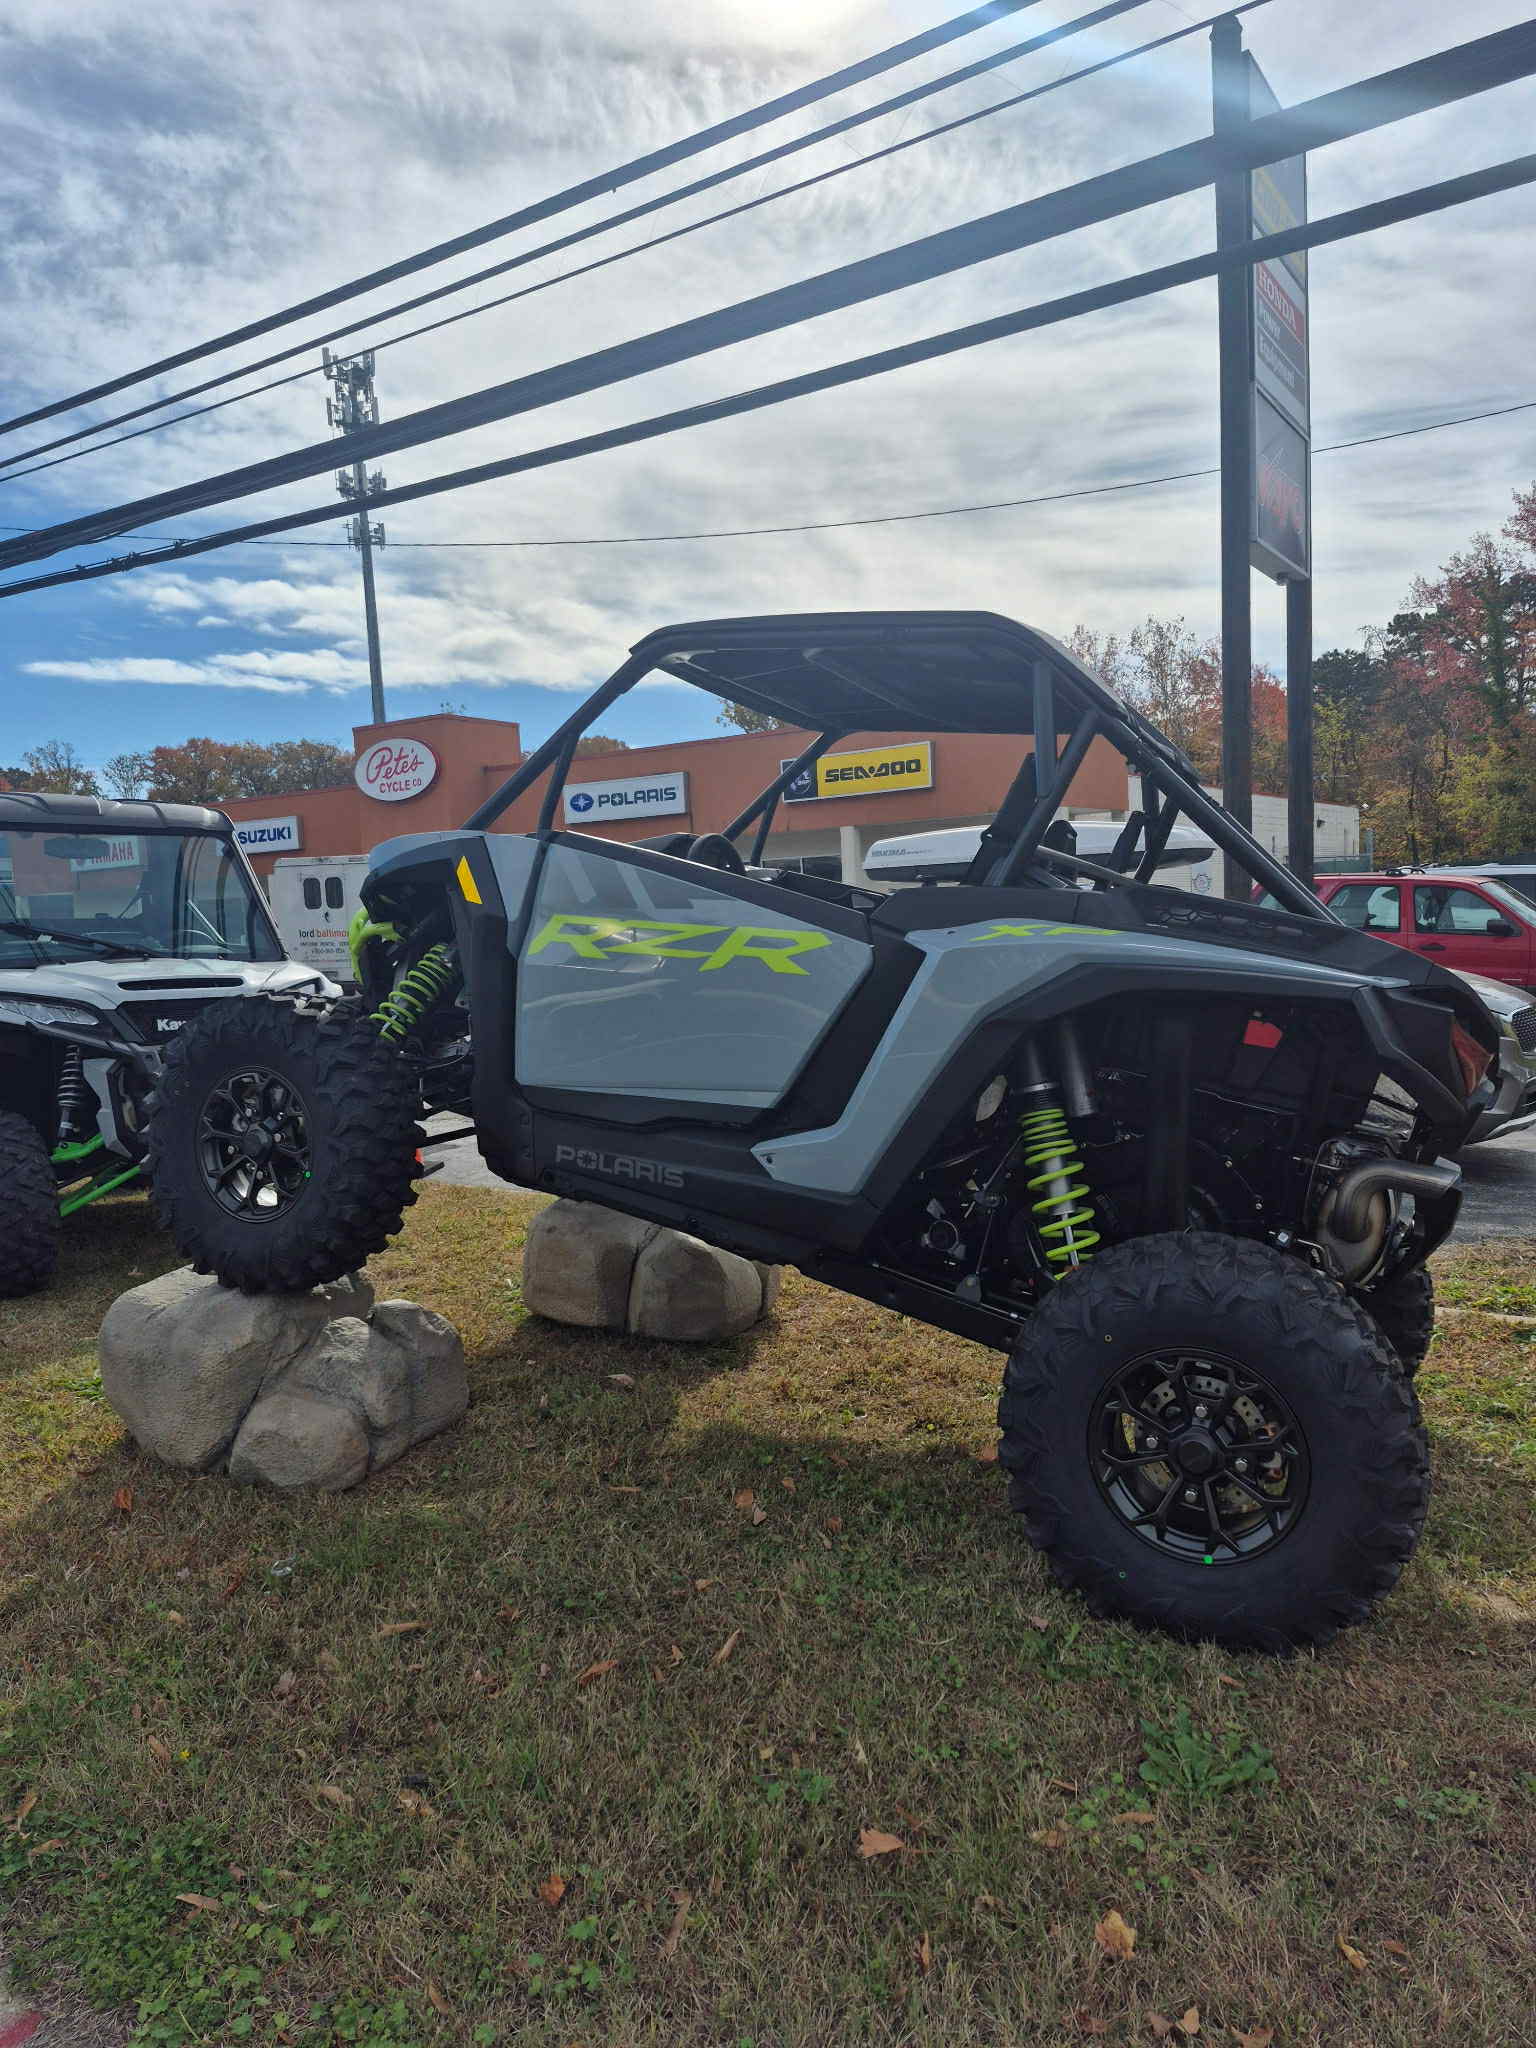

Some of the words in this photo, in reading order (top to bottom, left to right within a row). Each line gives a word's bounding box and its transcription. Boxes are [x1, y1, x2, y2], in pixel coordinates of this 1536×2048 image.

[1257, 268, 1297, 333] HONDA
[366, 746, 424, 784] Pete's
[379, 780, 412, 793] CYCLE
[598, 787, 677, 808] POLARIS
[237, 826, 291, 845] SUZUKI
[299, 929, 314, 938] lord
[528, 914, 832, 976] RZR
[556, 1144, 684, 1188] POLARIS
